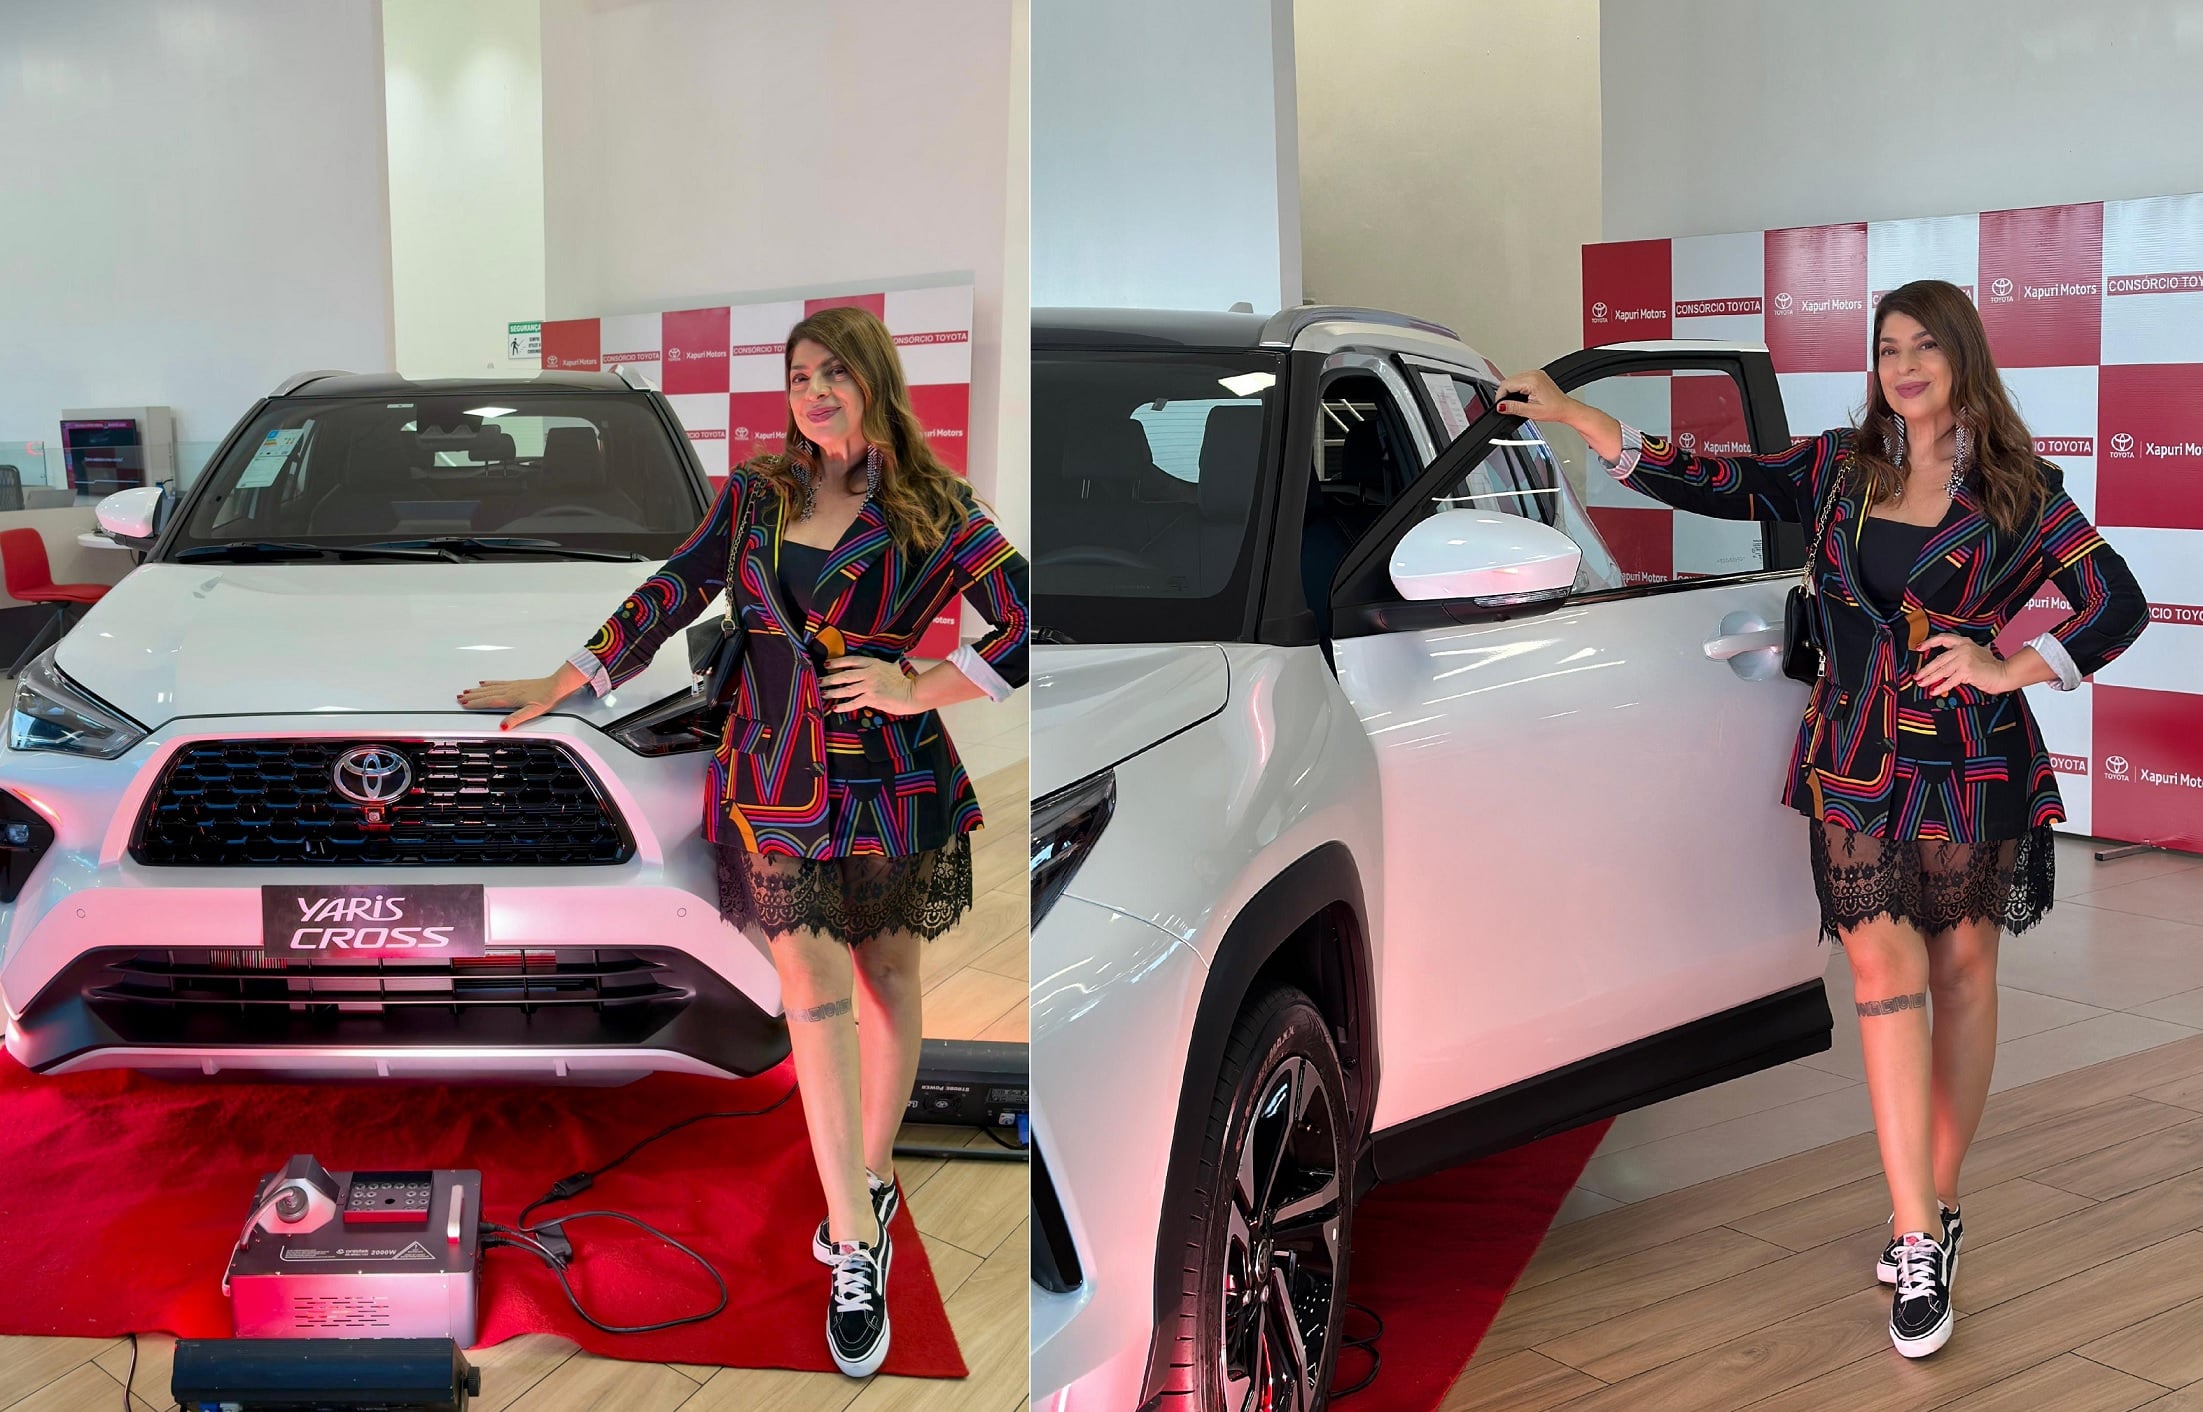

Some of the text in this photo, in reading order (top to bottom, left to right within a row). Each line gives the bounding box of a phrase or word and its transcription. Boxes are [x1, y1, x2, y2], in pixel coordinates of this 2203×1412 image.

[2108, 276, 2203, 292] CONSÓRCIO TOY
[2024, 283, 2097, 300] Xapuri Motors
[1675, 300, 1761, 315] CONSÓRCIO TOYOTA
[1802, 299, 1831, 314] Xapuri
[1832, 298, 1863, 310] Motors
[1615, 308, 1667, 323] Xapuri Motors
[893, 333, 967, 345] ONSÓRCIO TOYOTA
[637, 352, 660, 361] TOYOTA
[686, 350, 727, 360] Xapuri Motors
[733, 345, 772, 355] CONSÓRCIO
[754, 431, 775, 440] Xapuri
[936, 428, 963, 437] Motors
[1703, 440, 1730, 455] Xapuri
[1731, 441, 1751, 453] Moto
[2048, 440, 2092, 453] TOYOTA
[2145, 442, 2183, 458] Xapuri
[1621, 571, 1641, 583] apuri
[1642, 572, 1668, 583] Motors
[2024, 597, 2073, 611] puri Mot
[2050, 757, 2086, 772] OYOTA
[2104, 772, 2130, 782] TOYOTA
[2140, 768, 2203, 788] Xapuri Mot
[290, 926, 455, 950] CROSS
